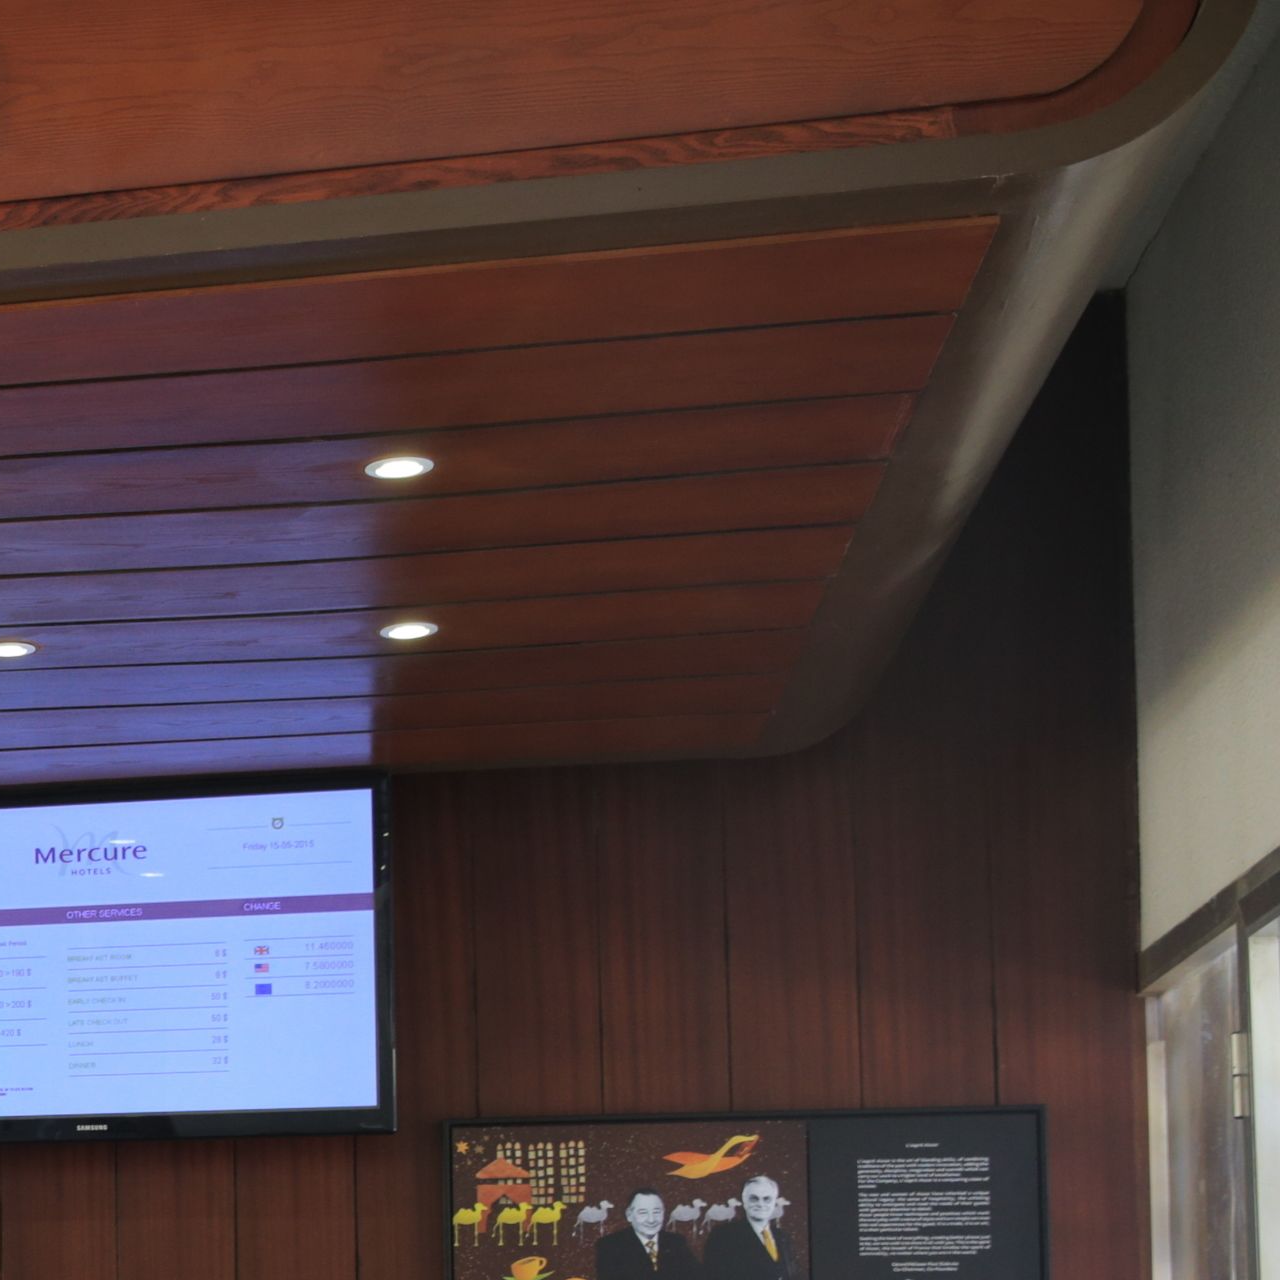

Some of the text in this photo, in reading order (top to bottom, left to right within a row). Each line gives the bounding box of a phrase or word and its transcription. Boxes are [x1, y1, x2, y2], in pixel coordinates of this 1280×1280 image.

[243, 841, 267, 851] Friday
[34, 843, 148, 864] Mercure
[71, 867, 112, 876] HOTELS
[243, 902, 281, 912] CHANGE
[66, 908, 143, 919] OTHER SERVICES
